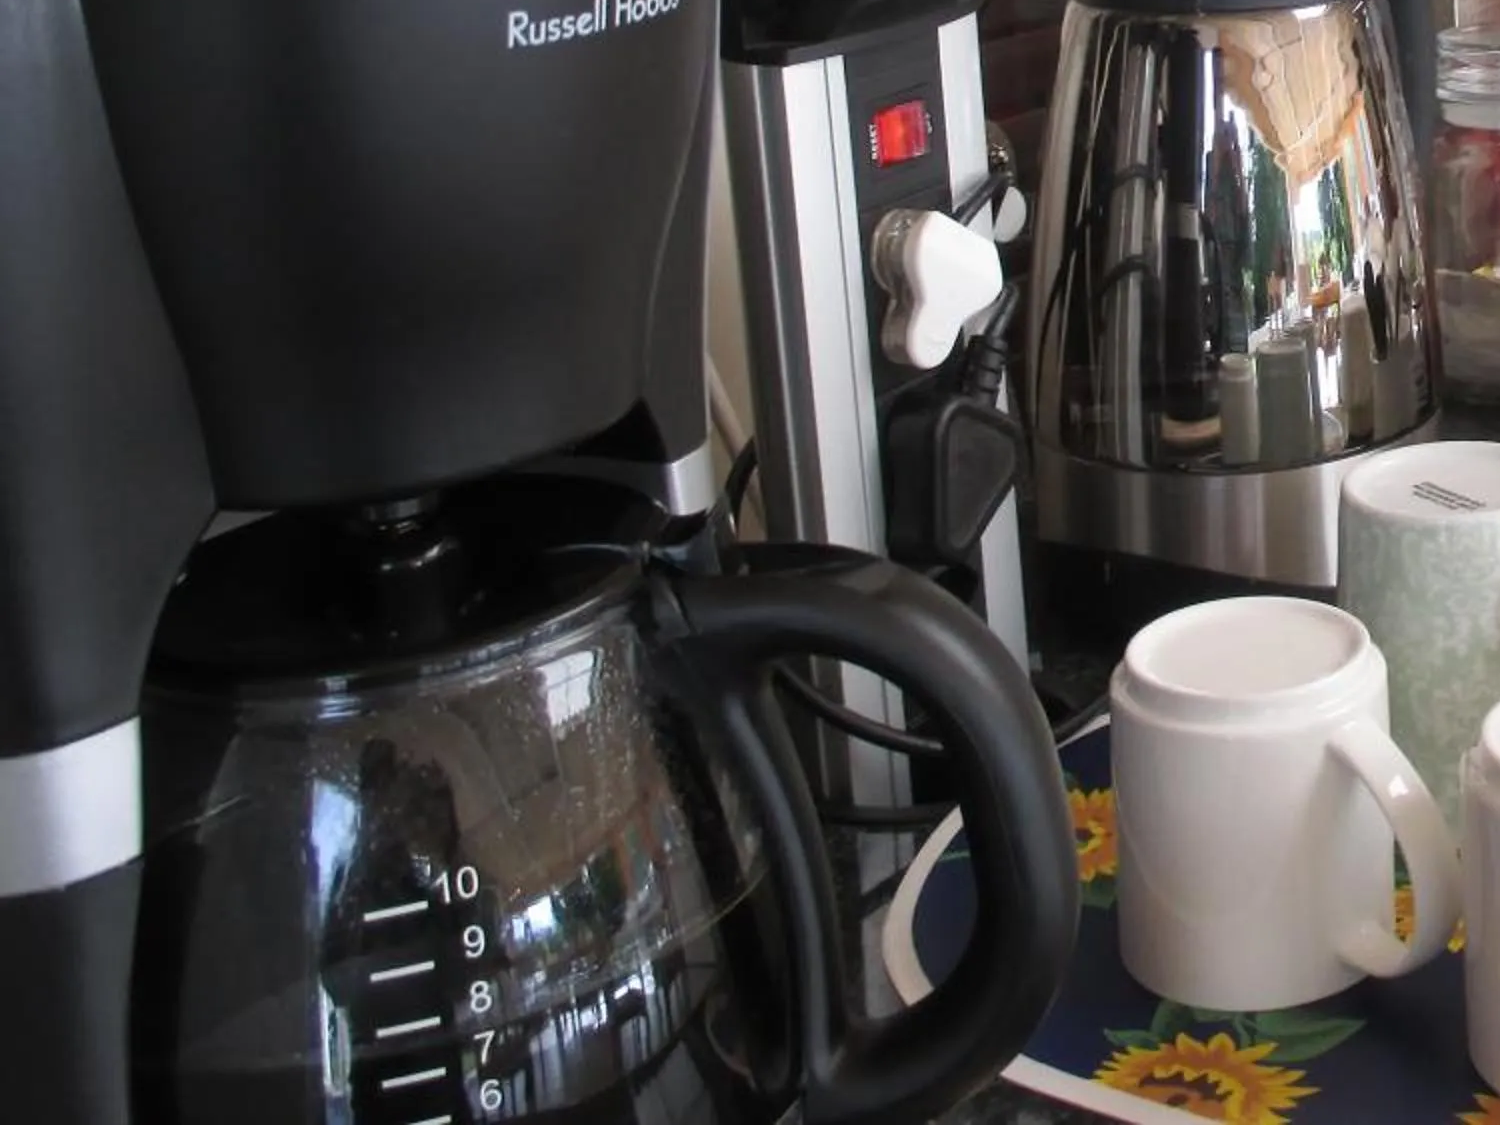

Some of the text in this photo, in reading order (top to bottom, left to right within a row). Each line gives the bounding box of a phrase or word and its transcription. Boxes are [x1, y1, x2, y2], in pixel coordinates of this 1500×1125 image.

[430, 865, 479, 904] 10
[462, 925, 486, 958] 9
[469, 980, 493, 1013] 8
[473, 1030, 495, 1064] 7
[479, 1078, 503, 1111] 6
